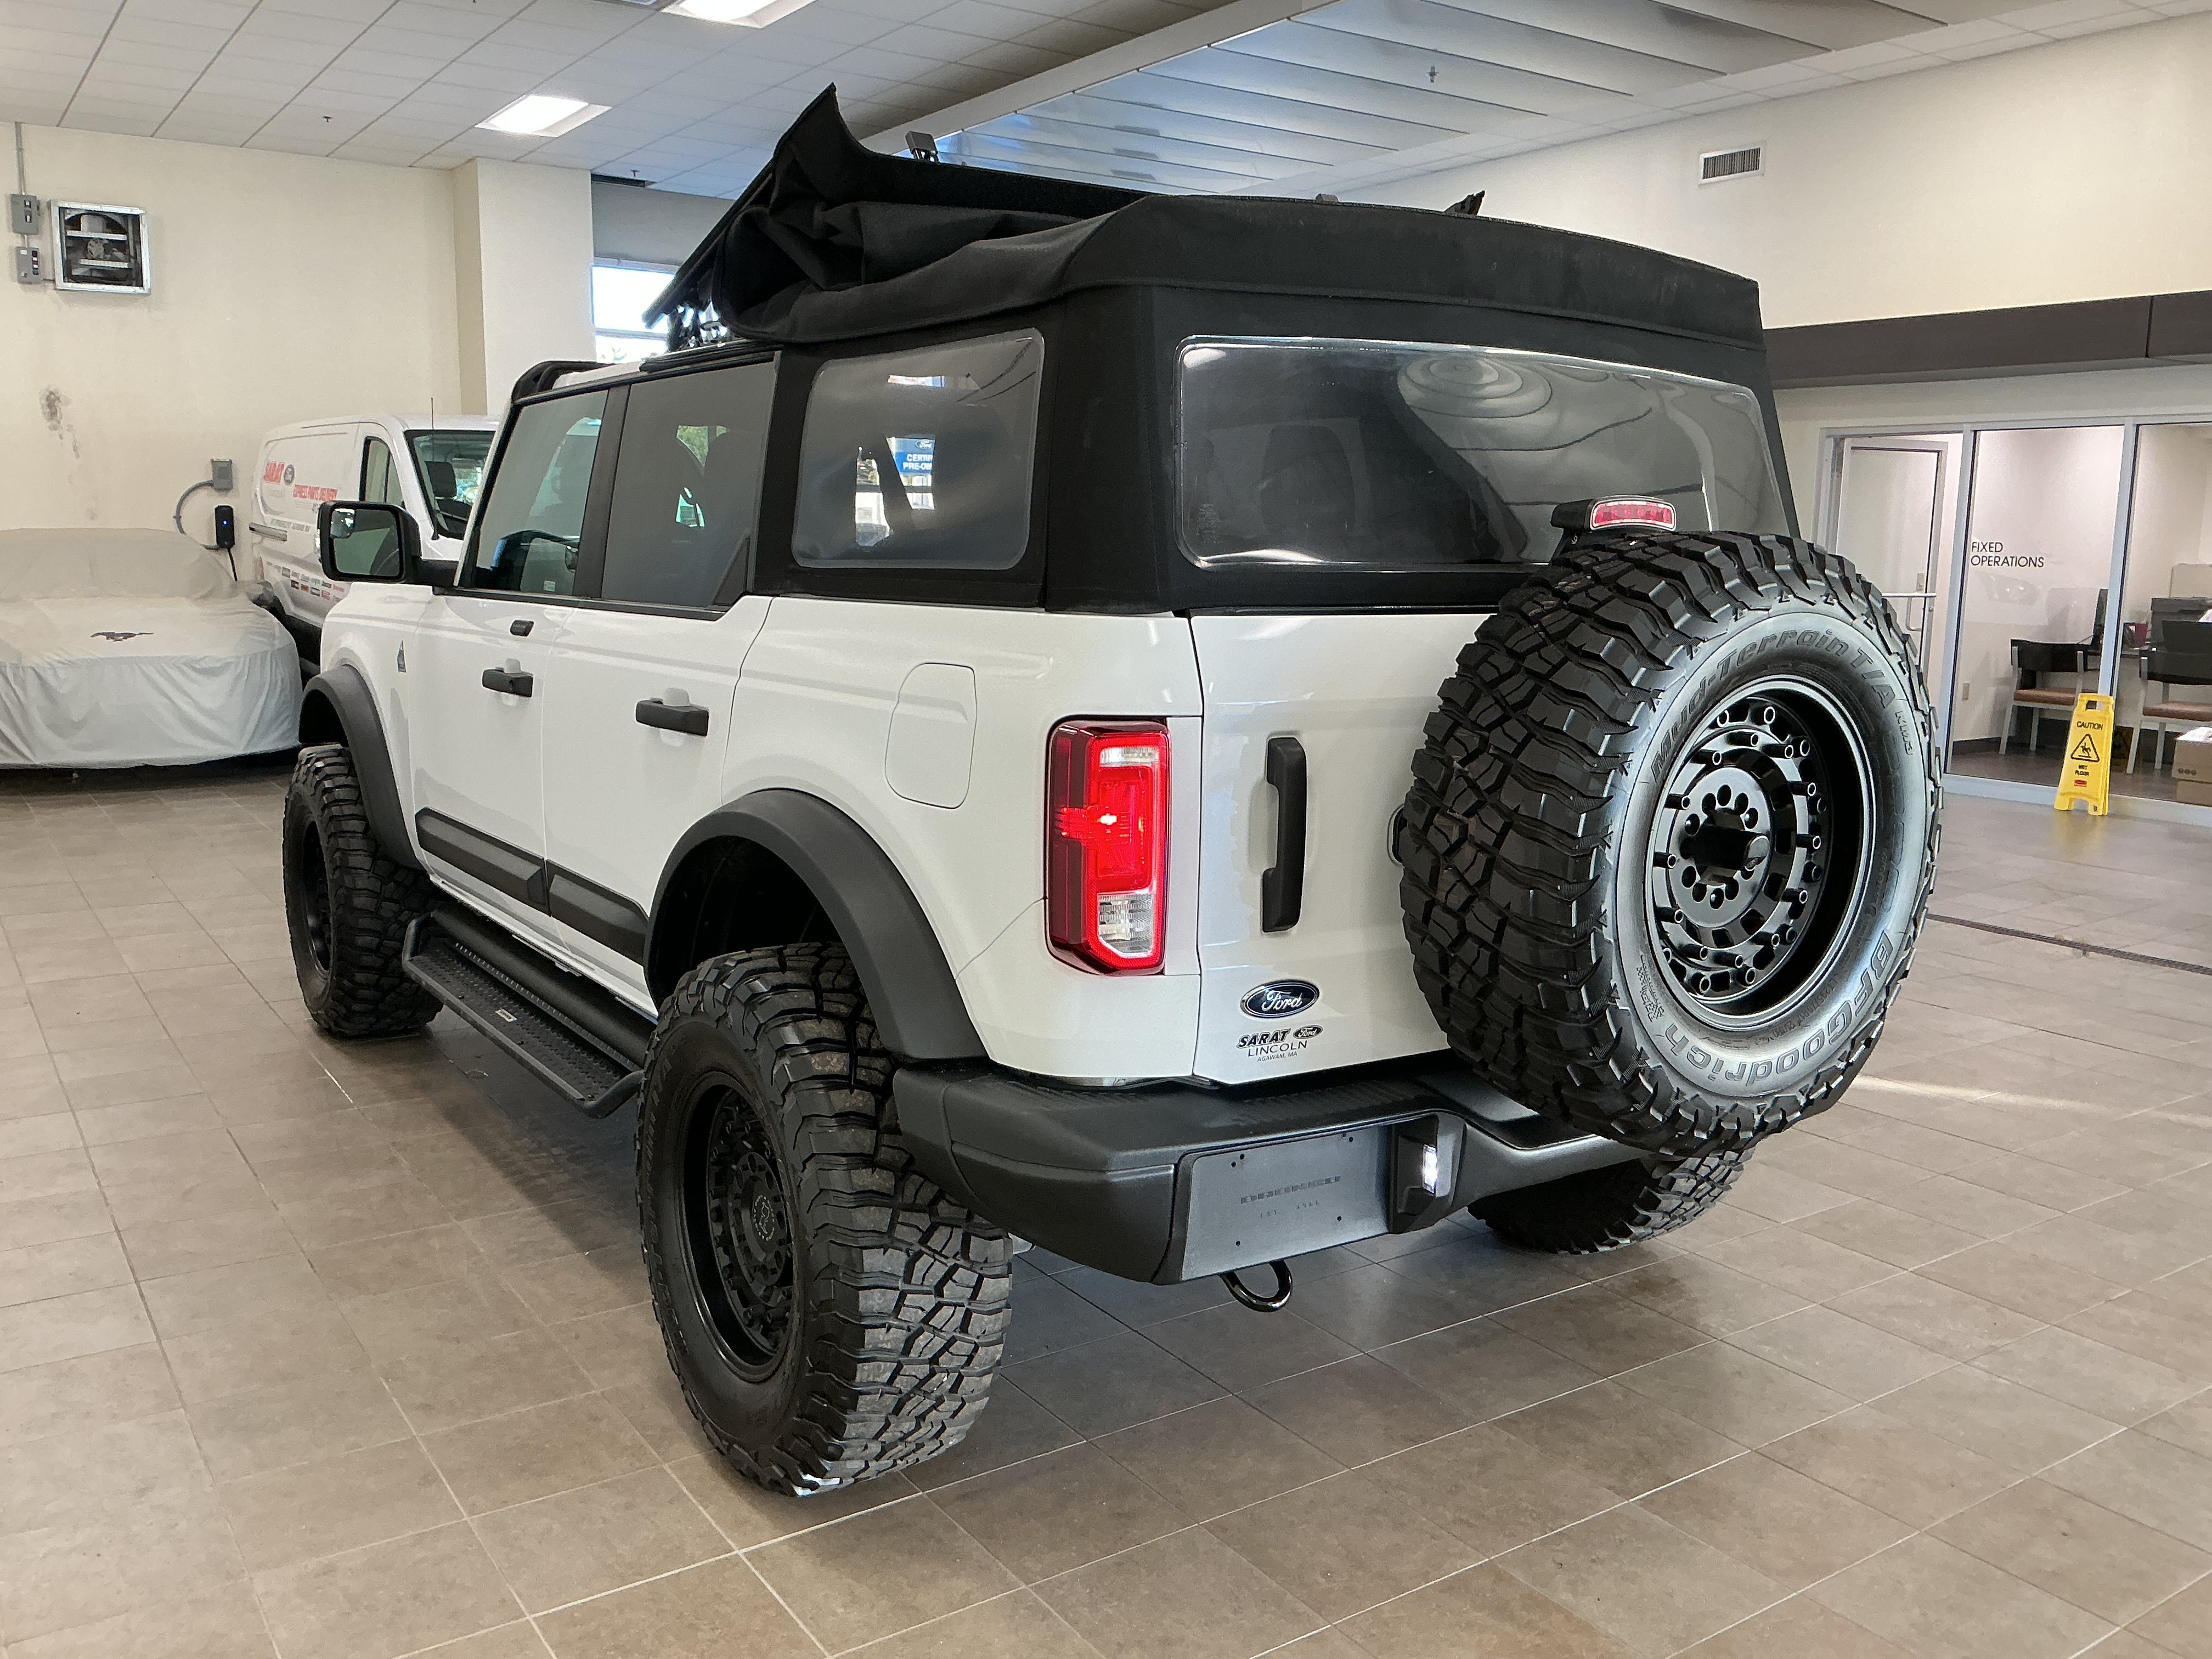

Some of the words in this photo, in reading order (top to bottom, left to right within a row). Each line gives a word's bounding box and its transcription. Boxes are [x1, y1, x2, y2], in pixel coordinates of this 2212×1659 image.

[906, 454, 933, 462] CERTIF
[902, 462, 933, 470] PRE-OW
[1971, 541, 2004, 552] FIXED
[1971, 555, 2045, 568] OPERATIONS
[2076, 721, 2103, 731] CAUTION
[1261, 990, 1303, 1012] Ford
[1664, 929, 1893, 1086] BFGoodrich
[1237, 1028, 1291, 1048] SARAT
[1248, 1040, 1307, 1057] LINCOLN
